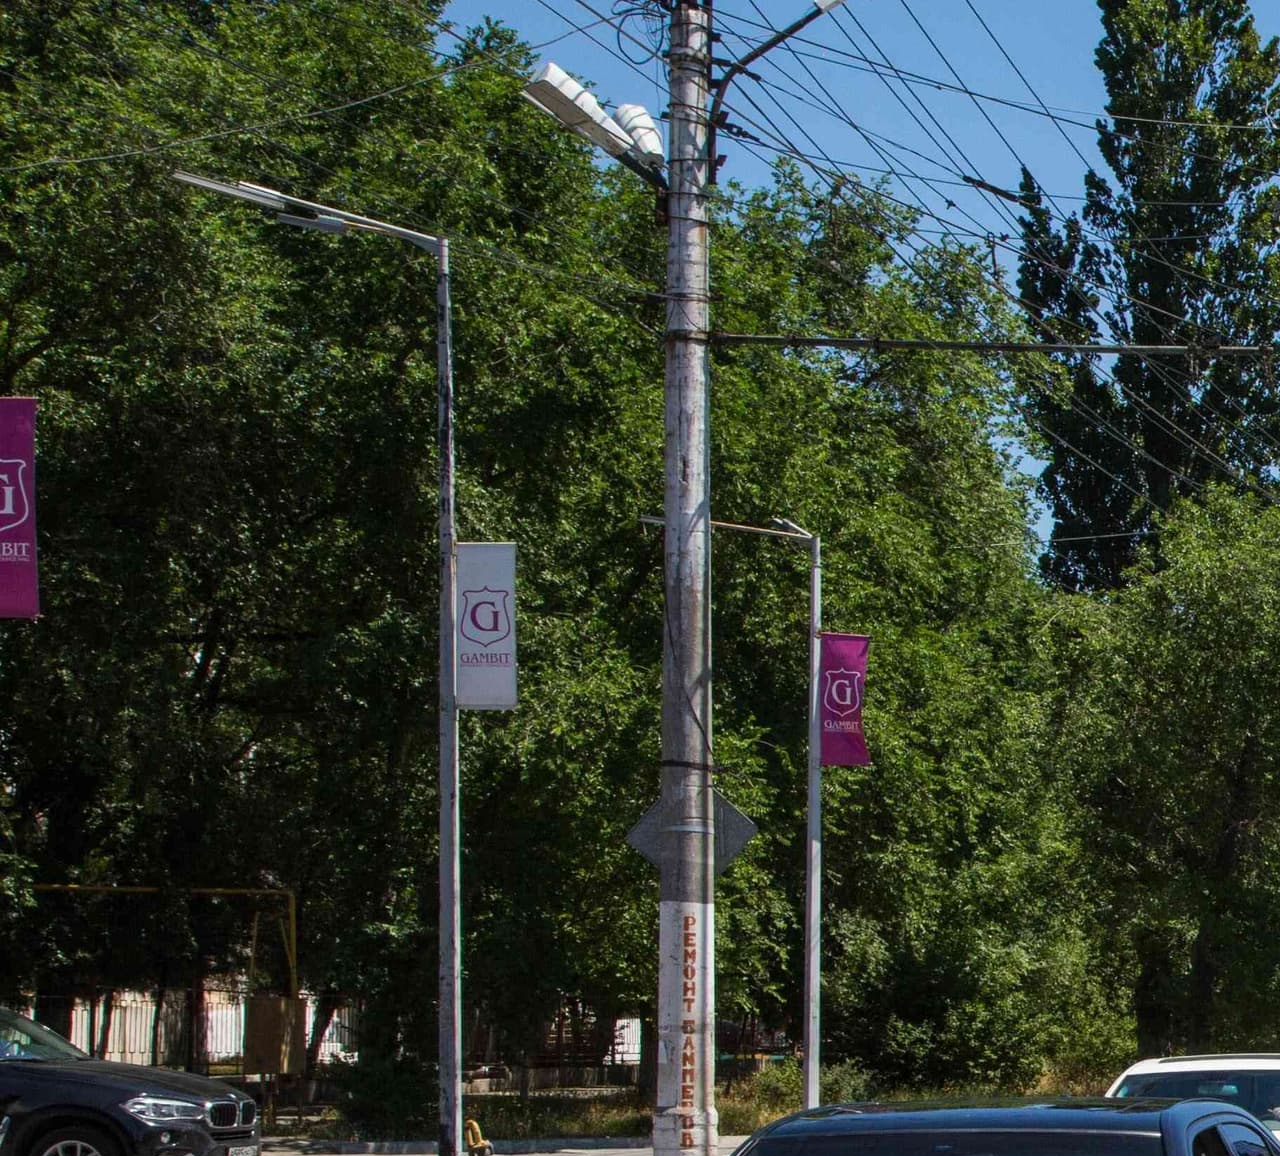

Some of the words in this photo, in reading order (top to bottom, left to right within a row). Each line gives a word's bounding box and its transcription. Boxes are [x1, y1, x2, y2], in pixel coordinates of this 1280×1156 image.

[470, 600, 500, 632] G
[460, 653, 511, 664] GAMBIT
[824, 720, 859, 729] GAMBIT
[683, 915, 697, 1013] РЕМОНТ
